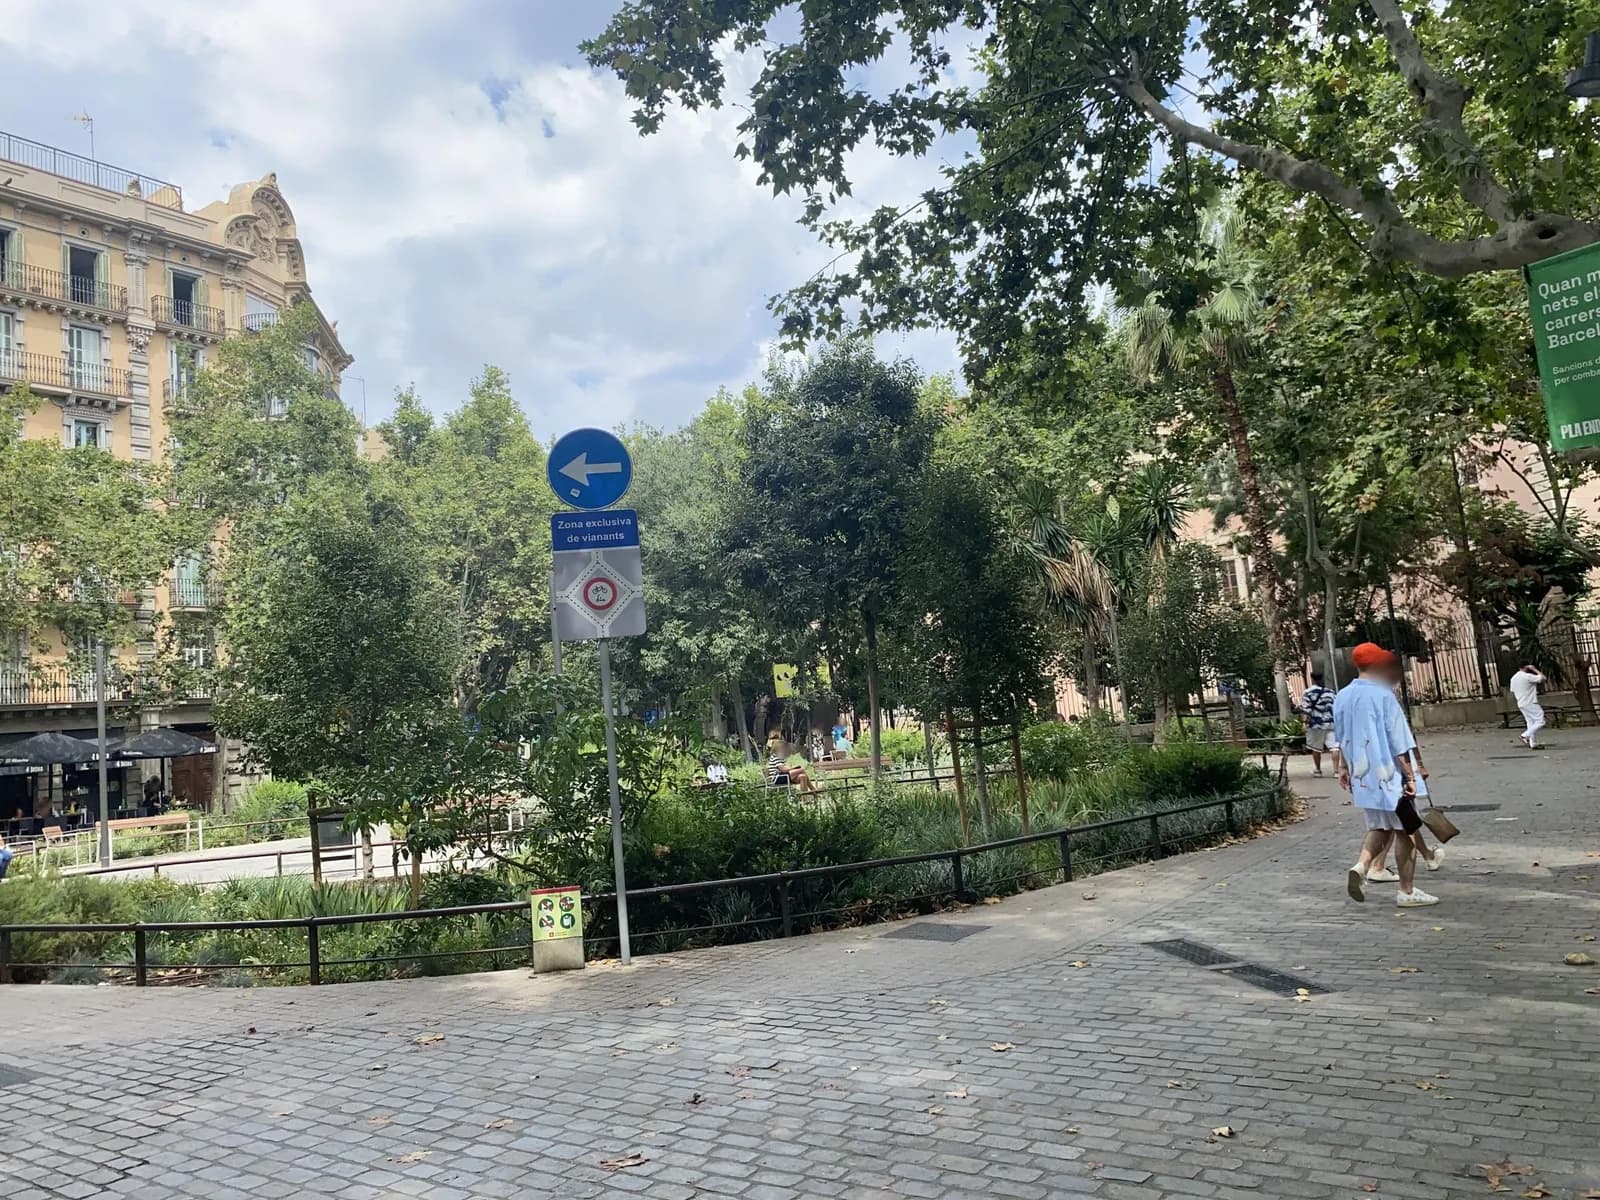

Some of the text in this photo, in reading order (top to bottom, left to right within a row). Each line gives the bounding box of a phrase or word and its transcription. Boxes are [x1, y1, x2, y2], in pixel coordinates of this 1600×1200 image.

[1538, 276, 1582, 299] Quan
[1542, 286, 1600, 315] nets el
[1547, 323, 1600, 349] Barcel
[1552, 359, 1593, 375] Sancions
[1554, 376, 1570, 387] per
[1560, 423, 1582, 440] PLA
[557, 518, 632, 529] Zona exclusiva
[567, 532, 625, 543] de vianants
